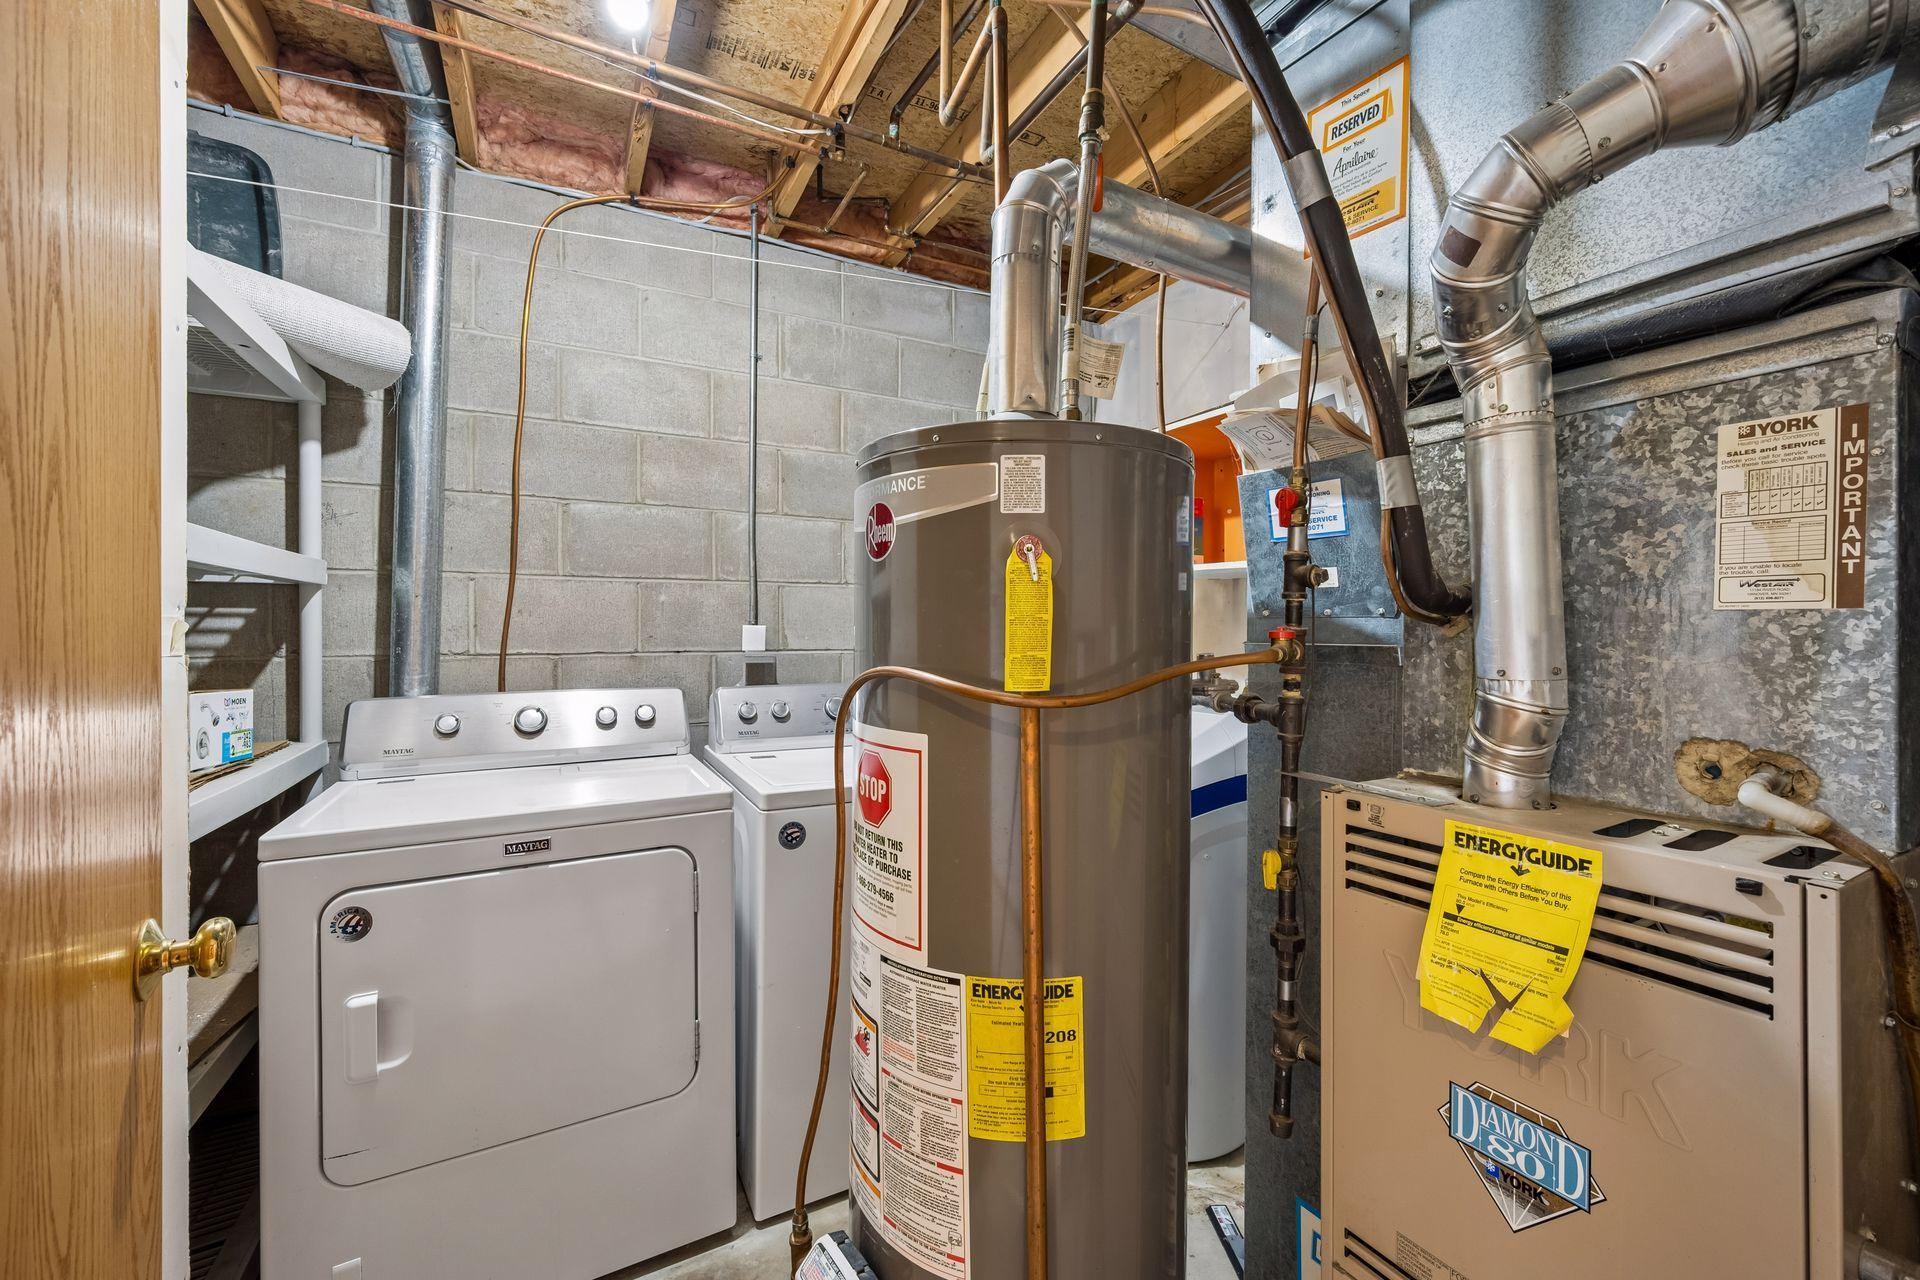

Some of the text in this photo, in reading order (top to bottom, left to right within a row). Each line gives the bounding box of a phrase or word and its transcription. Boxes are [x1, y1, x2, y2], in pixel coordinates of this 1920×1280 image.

[1341, 87, 1370, 108] This Space
[1331, 103, 1380, 140] RESERVED
[1342, 138, 1366, 153] For Your
[1332, 150, 1376, 178] Aprilaire
[1352, 204, 1379, 220] SERVICE
[1757, 414, 1819, 436] YORK
[1726, 439, 1826, 458] SALES and SERVICE
[1737, 438, 1760, 447] Heating
[1782, 431, 1820, 441] Conditioning
[1721, 462, 1740, 470] check
[1780, 455, 1805, 463] trouble
[1806, 453, 1827, 461] spots
[1744, 456, 1757, 464] you
[1783, 449, 1808, 457] service
[1841, 423, 1865, 574] IMPORTANT
[867, 505, 893, 552] Rheem
[231, 698, 247, 706] MOEN
[860, 773, 887, 803] STOP
[507, 841, 548, 854] MAYTAG
[864, 829, 885, 844] RETURN
[887, 838, 903, 853] THIS
[866, 841, 887, 860] HEATER
[889, 852, 898, 864] TO
[1454, 831, 1593, 872] ENERGYGUIDE
[868, 855, 874, 867] OF
[875, 859, 912, 882] PURCHASE
[1459, 876, 1570, 911] Furnace with Others Before You Buy.
[1460, 867, 1572, 902] Compare the Energy Efficiency of this
[1467, 896, 1485, 906] Model's
[1486, 902, 1508, 913] Efficiency
[330, 908, 360, 934] AMERICA
[1440, 925, 1460, 934] Efficient
[1457, 916, 1473, 927] Energy
[1473, 921, 1496, 934] efficiency
[1495, 928, 1509, 938] range
[1509, 931, 1515, 939] of
[1521, 936, 1537, 946] similar
[1537, 940, 1555, 951] models
[1546, 959, 1565, 968] Efficient
[1045, 1030, 1076, 1044] 208
[1456, 1088, 1584, 1201] DIAMOND
[1487, 1134, 1546, 1181] 80
[1501, 1169, 1545, 1205] YORK
